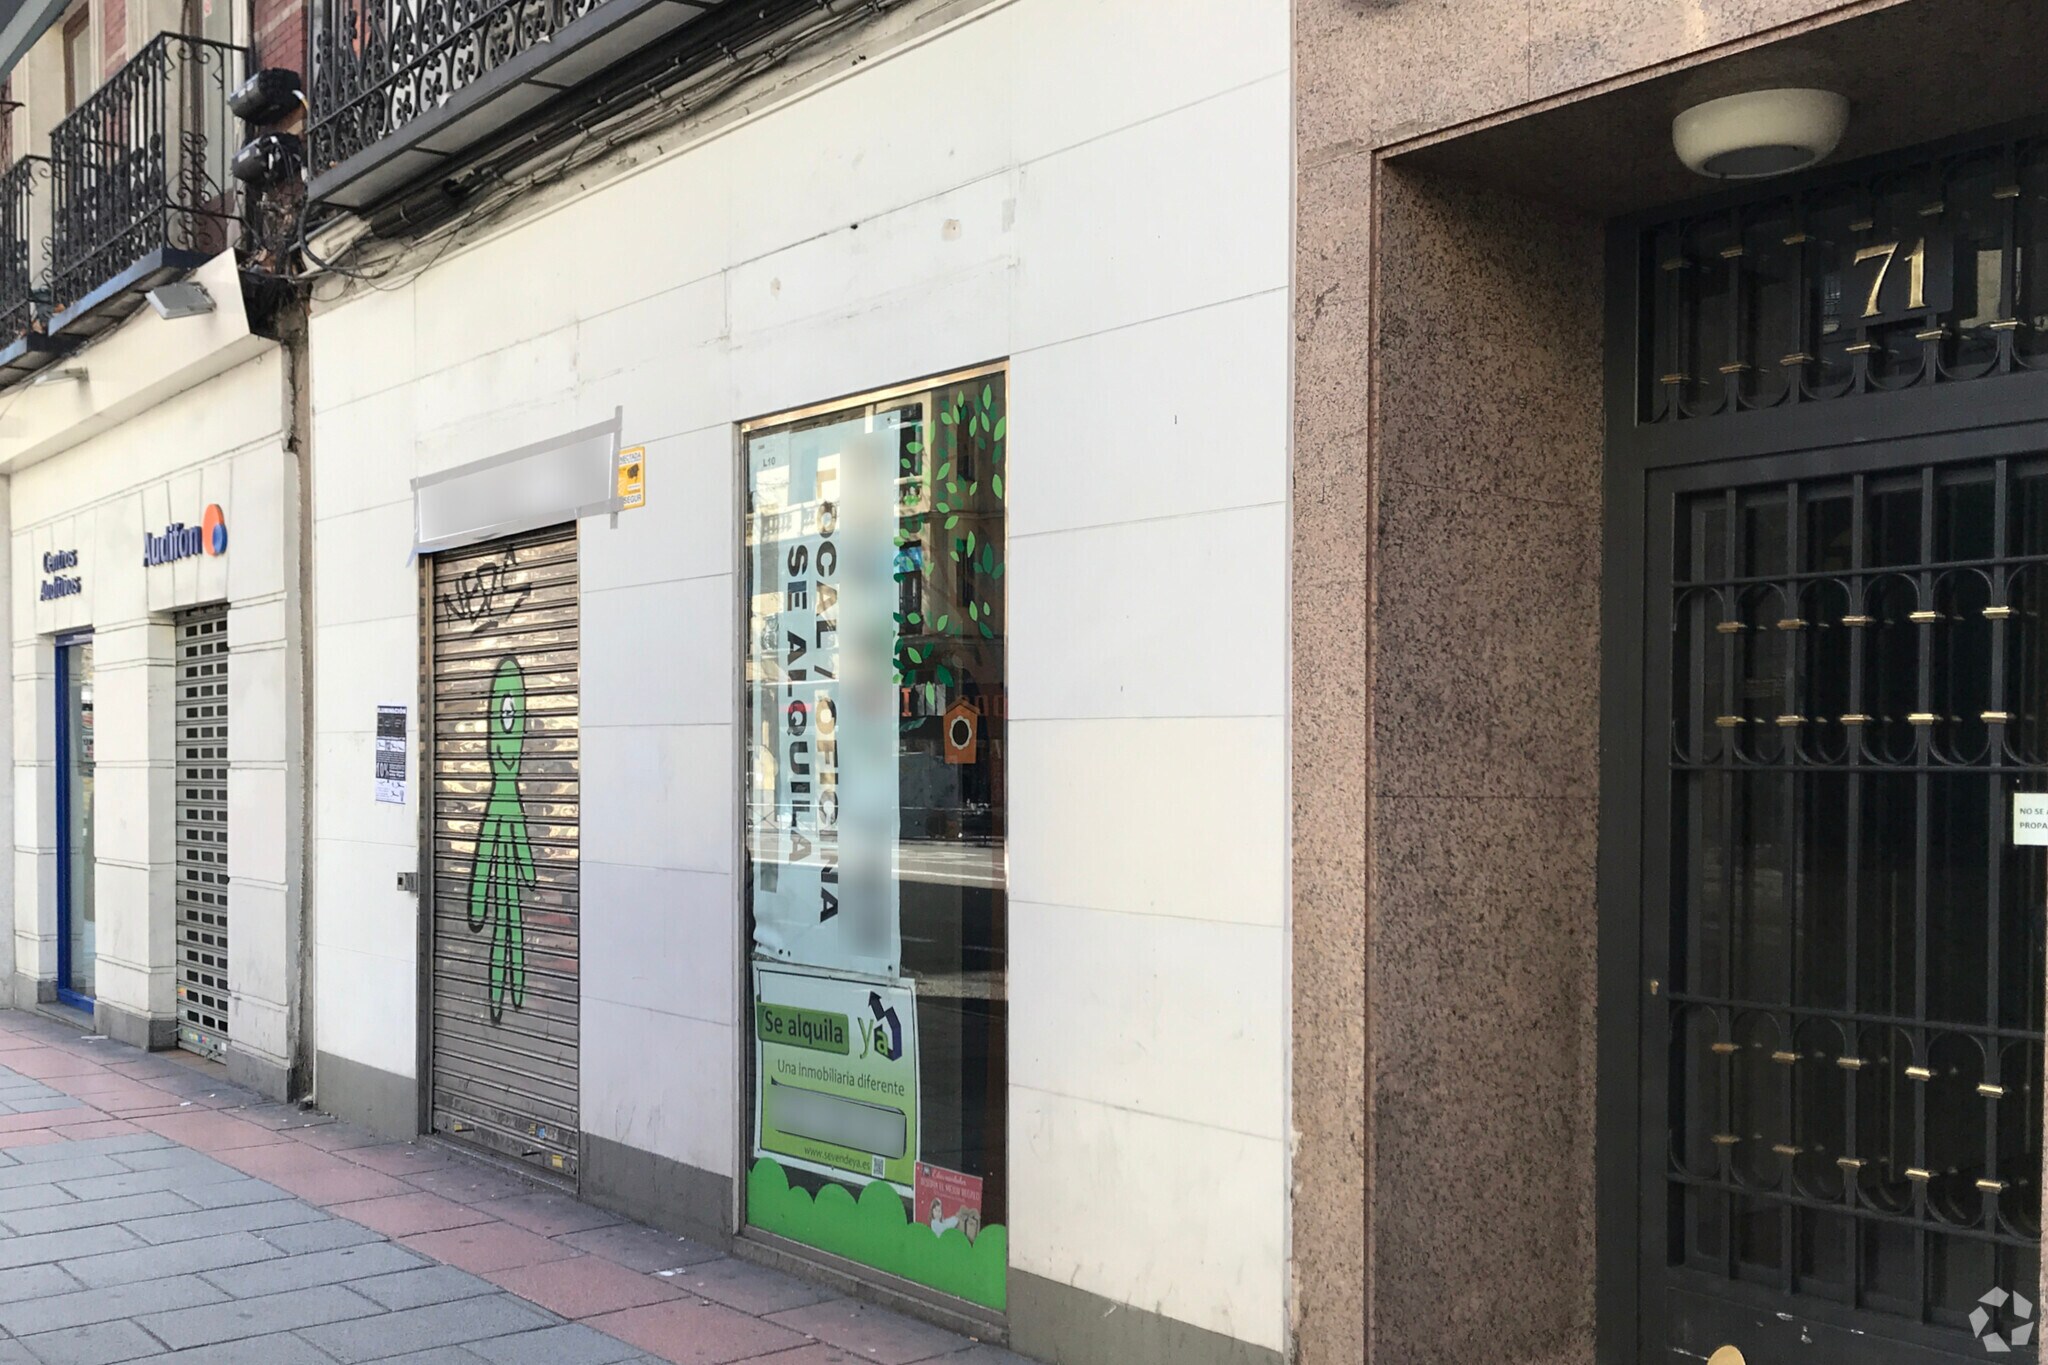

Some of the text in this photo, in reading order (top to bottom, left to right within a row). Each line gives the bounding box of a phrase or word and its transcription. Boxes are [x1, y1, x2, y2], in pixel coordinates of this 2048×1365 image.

[1854, 237, 1926, 318] 71
[763, 456, 776, 467] L10
[43, 550, 78, 573] Centros
[816, 468, 838, 649] LOCAL
[787, 544, 812, 862] SE ALQUILA
[815, 696, 839, 924] OFICINA
[765, 1010, 843, 1044] Se alquila
[857, 1017, 889, 1060] ya
[778, 1059, 797, 1075] Una
[858, 1073, 905, 1097] diferente
